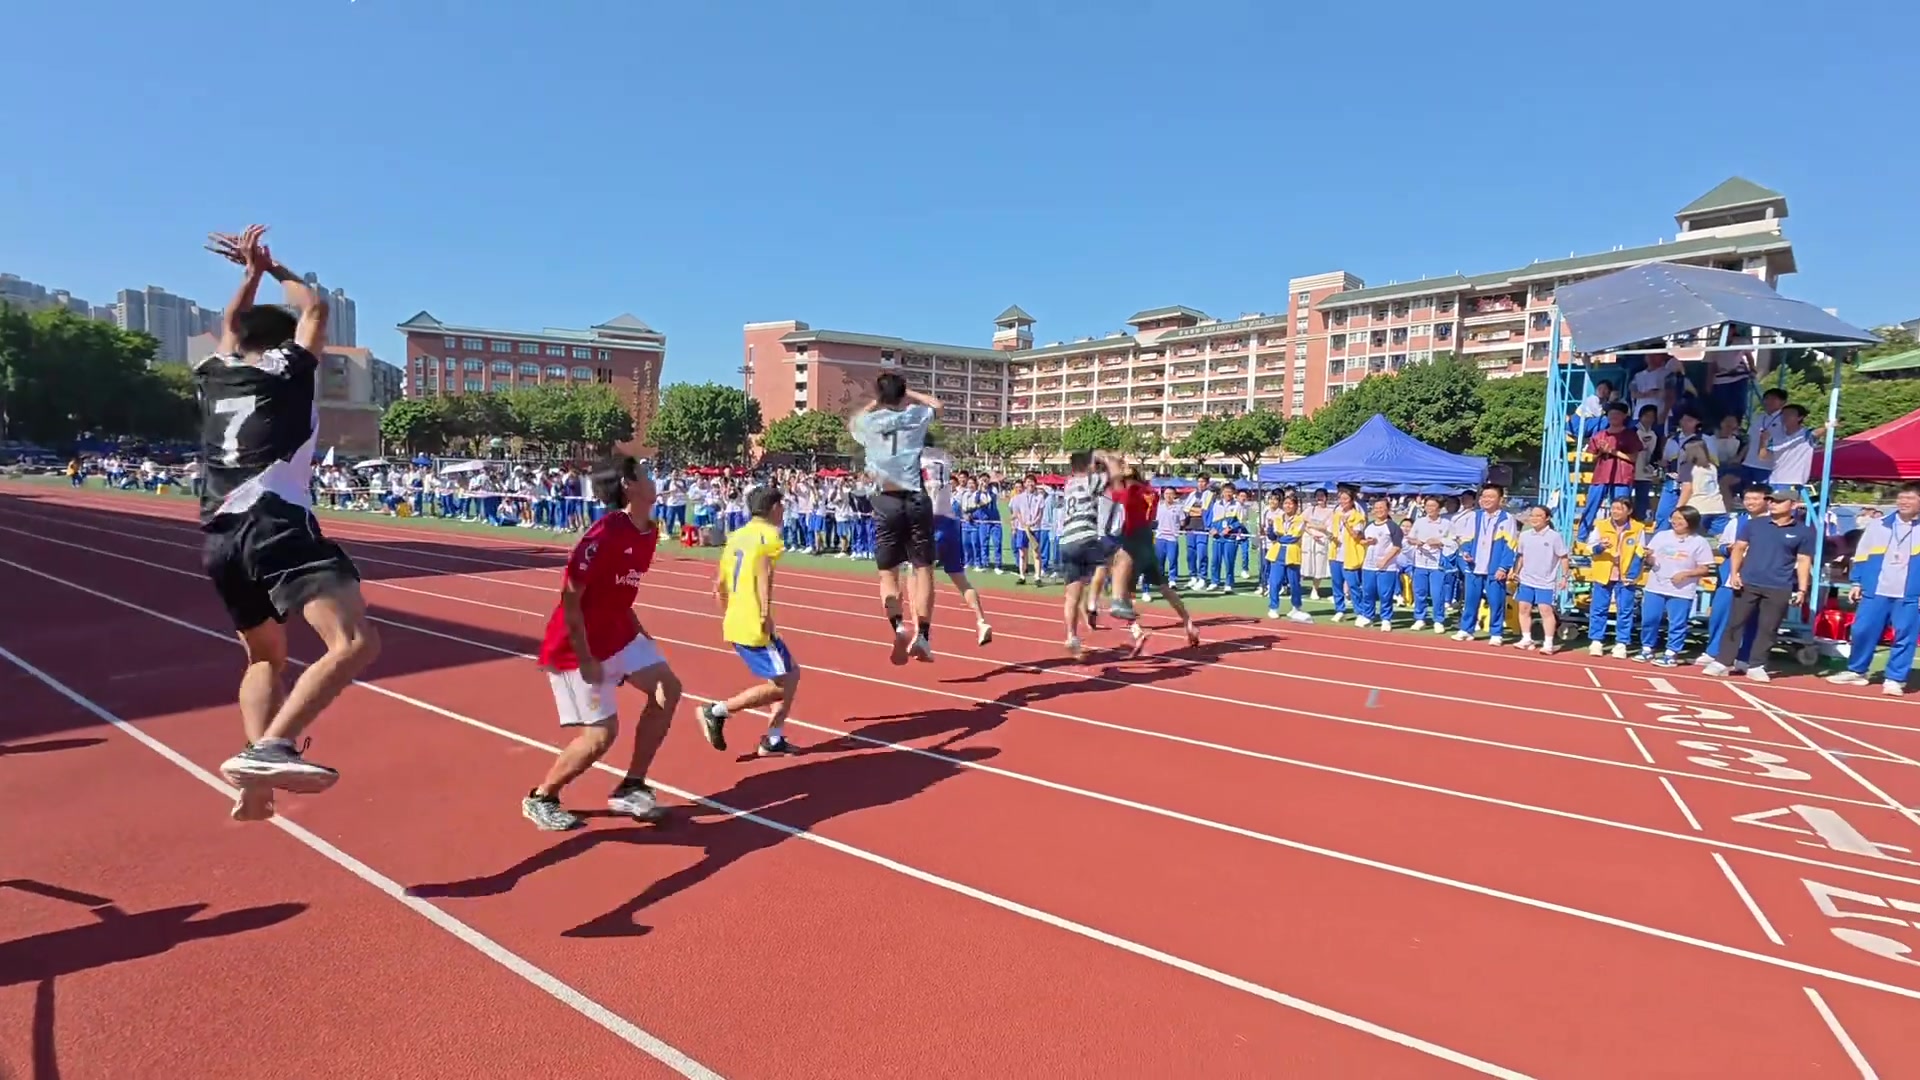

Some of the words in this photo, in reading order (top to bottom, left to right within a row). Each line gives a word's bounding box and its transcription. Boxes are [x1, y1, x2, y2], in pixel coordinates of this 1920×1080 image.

[214, 395, 257, 468] 7
[881, 429, 899, 456] 7
[1632, 675, 1701, 697] 1
[1644, 702, 1752, 733] 2
[1676, 740, 1812, 780] 3
[1731, 804, 1920, 865] 4
